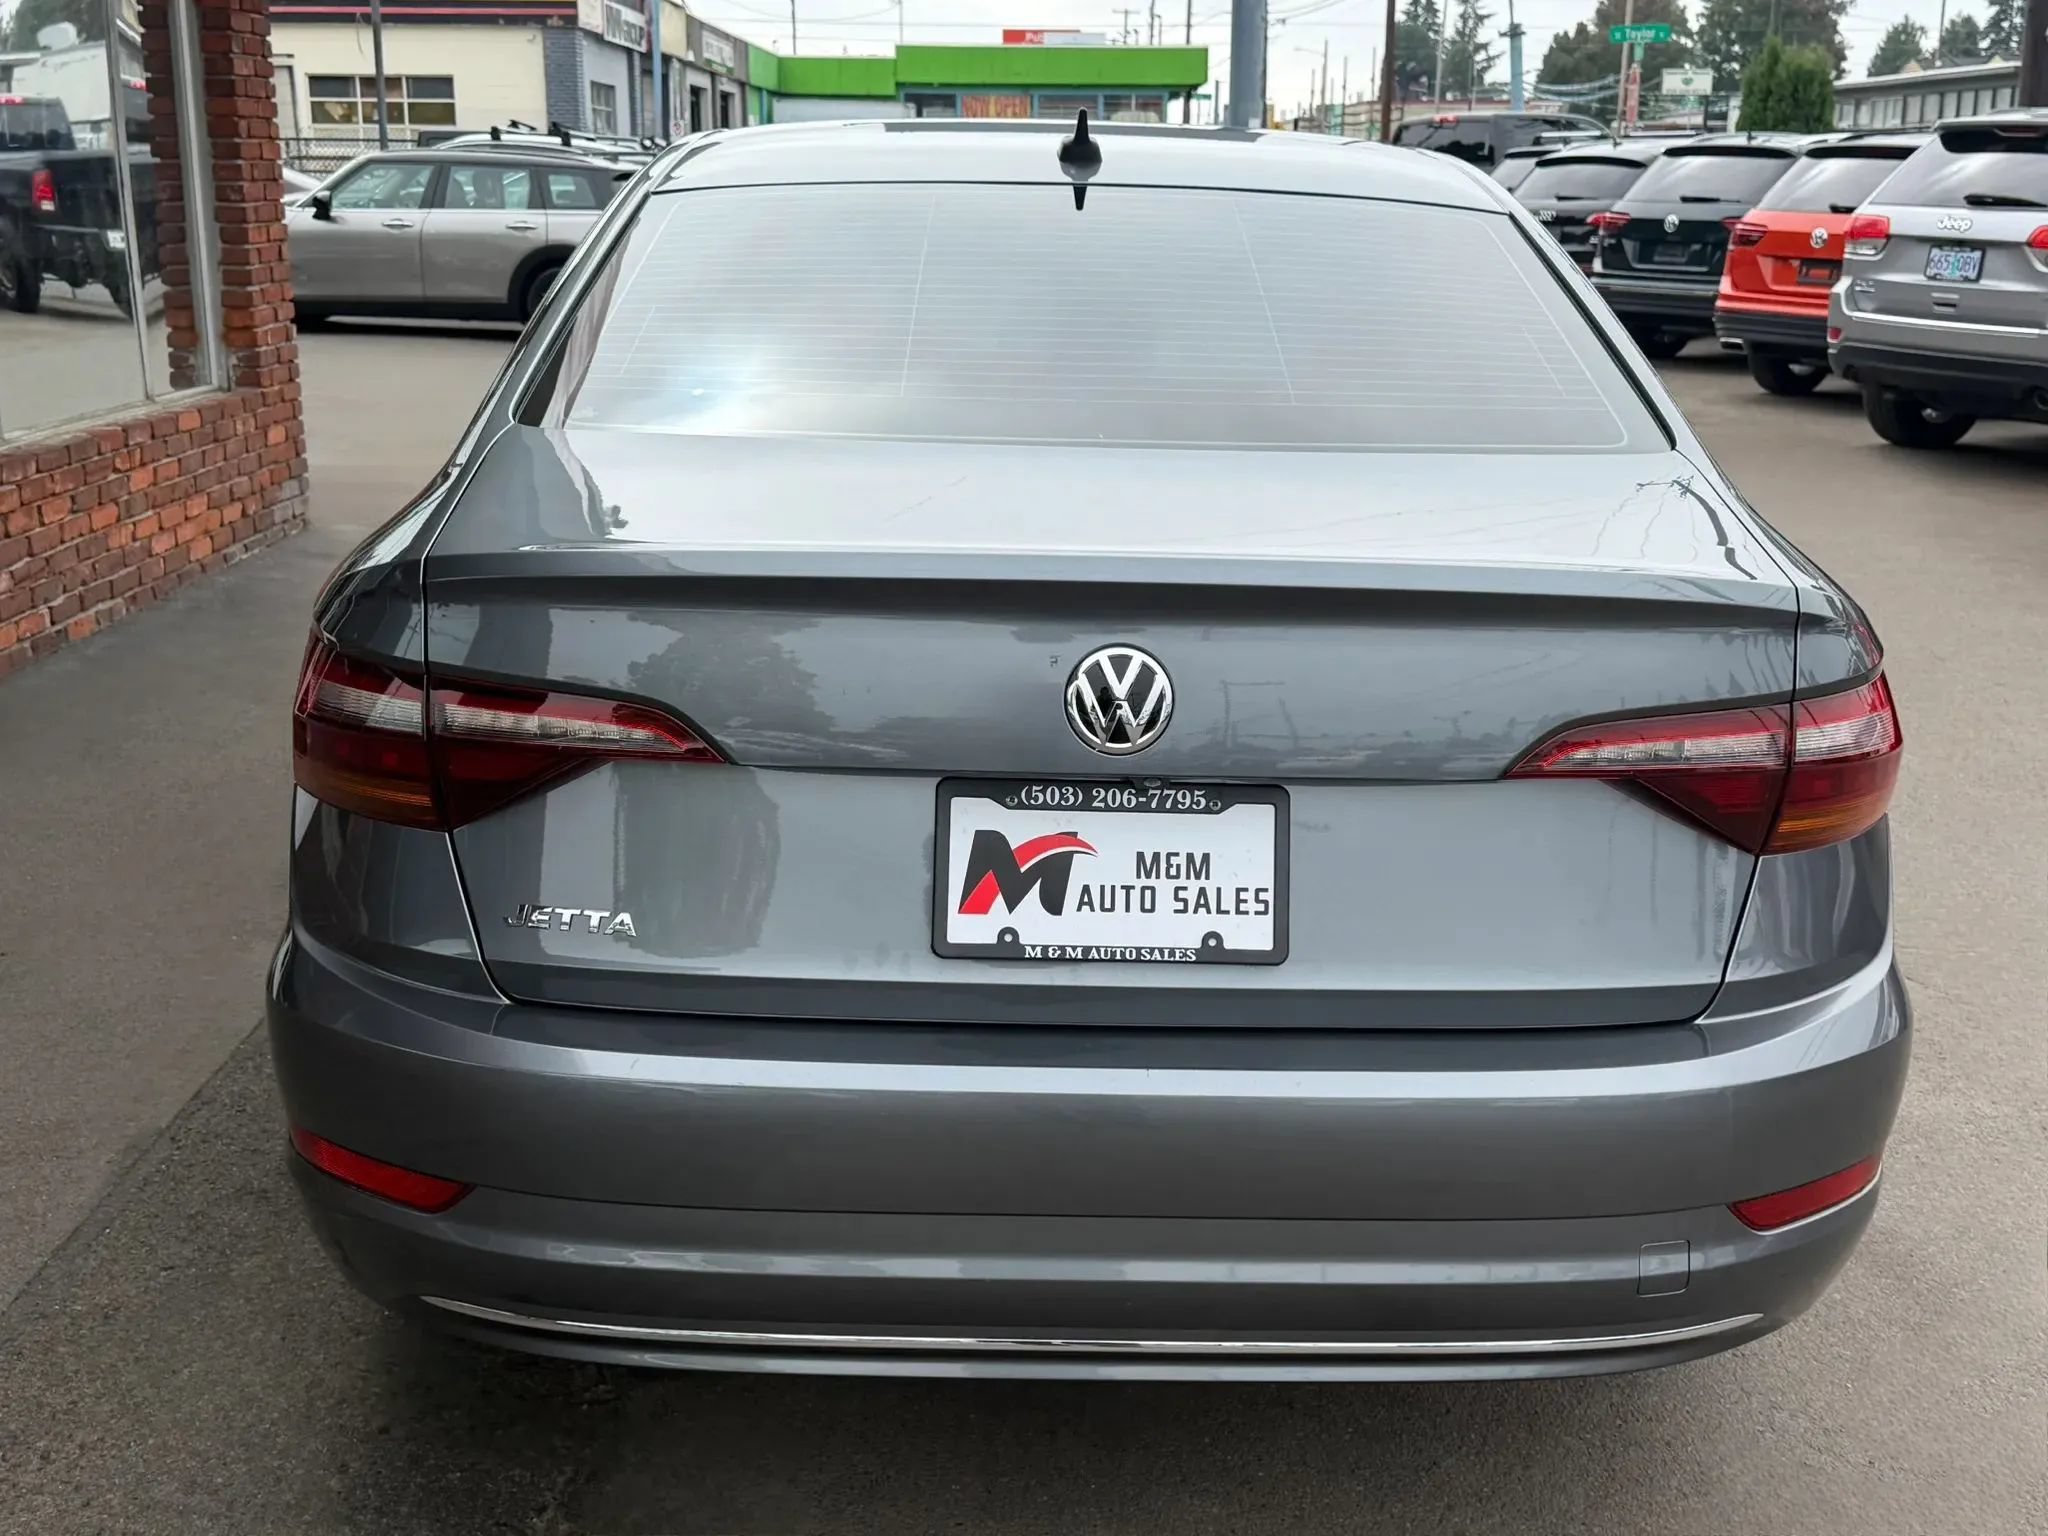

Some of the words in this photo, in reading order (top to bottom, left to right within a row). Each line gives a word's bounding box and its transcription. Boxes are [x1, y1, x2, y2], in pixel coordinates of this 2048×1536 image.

[1937, 214, 1973, 233] Jeep
[1928, 253, 1951, 271] 665
[1066, 646, 1173, 752] VW
[1020, 785, 1083, 806] (503)
[1091, 788, 1207, 809] 206-7795
[1136, 851, 1211, 881] M&M
[1076, 884, 1156, 914] AUTO
[1173, 885, 1270, 916] SALES
[503, 904, 637, 937] JETTA
[1024, 945, 1043, 958] M
[1048, 946, 1062, 959] &
[1065, 947, 1084, 959] M
[1088, 947, 1137, 960] AUTO
[1140, 948, 1197, 962] SALES
